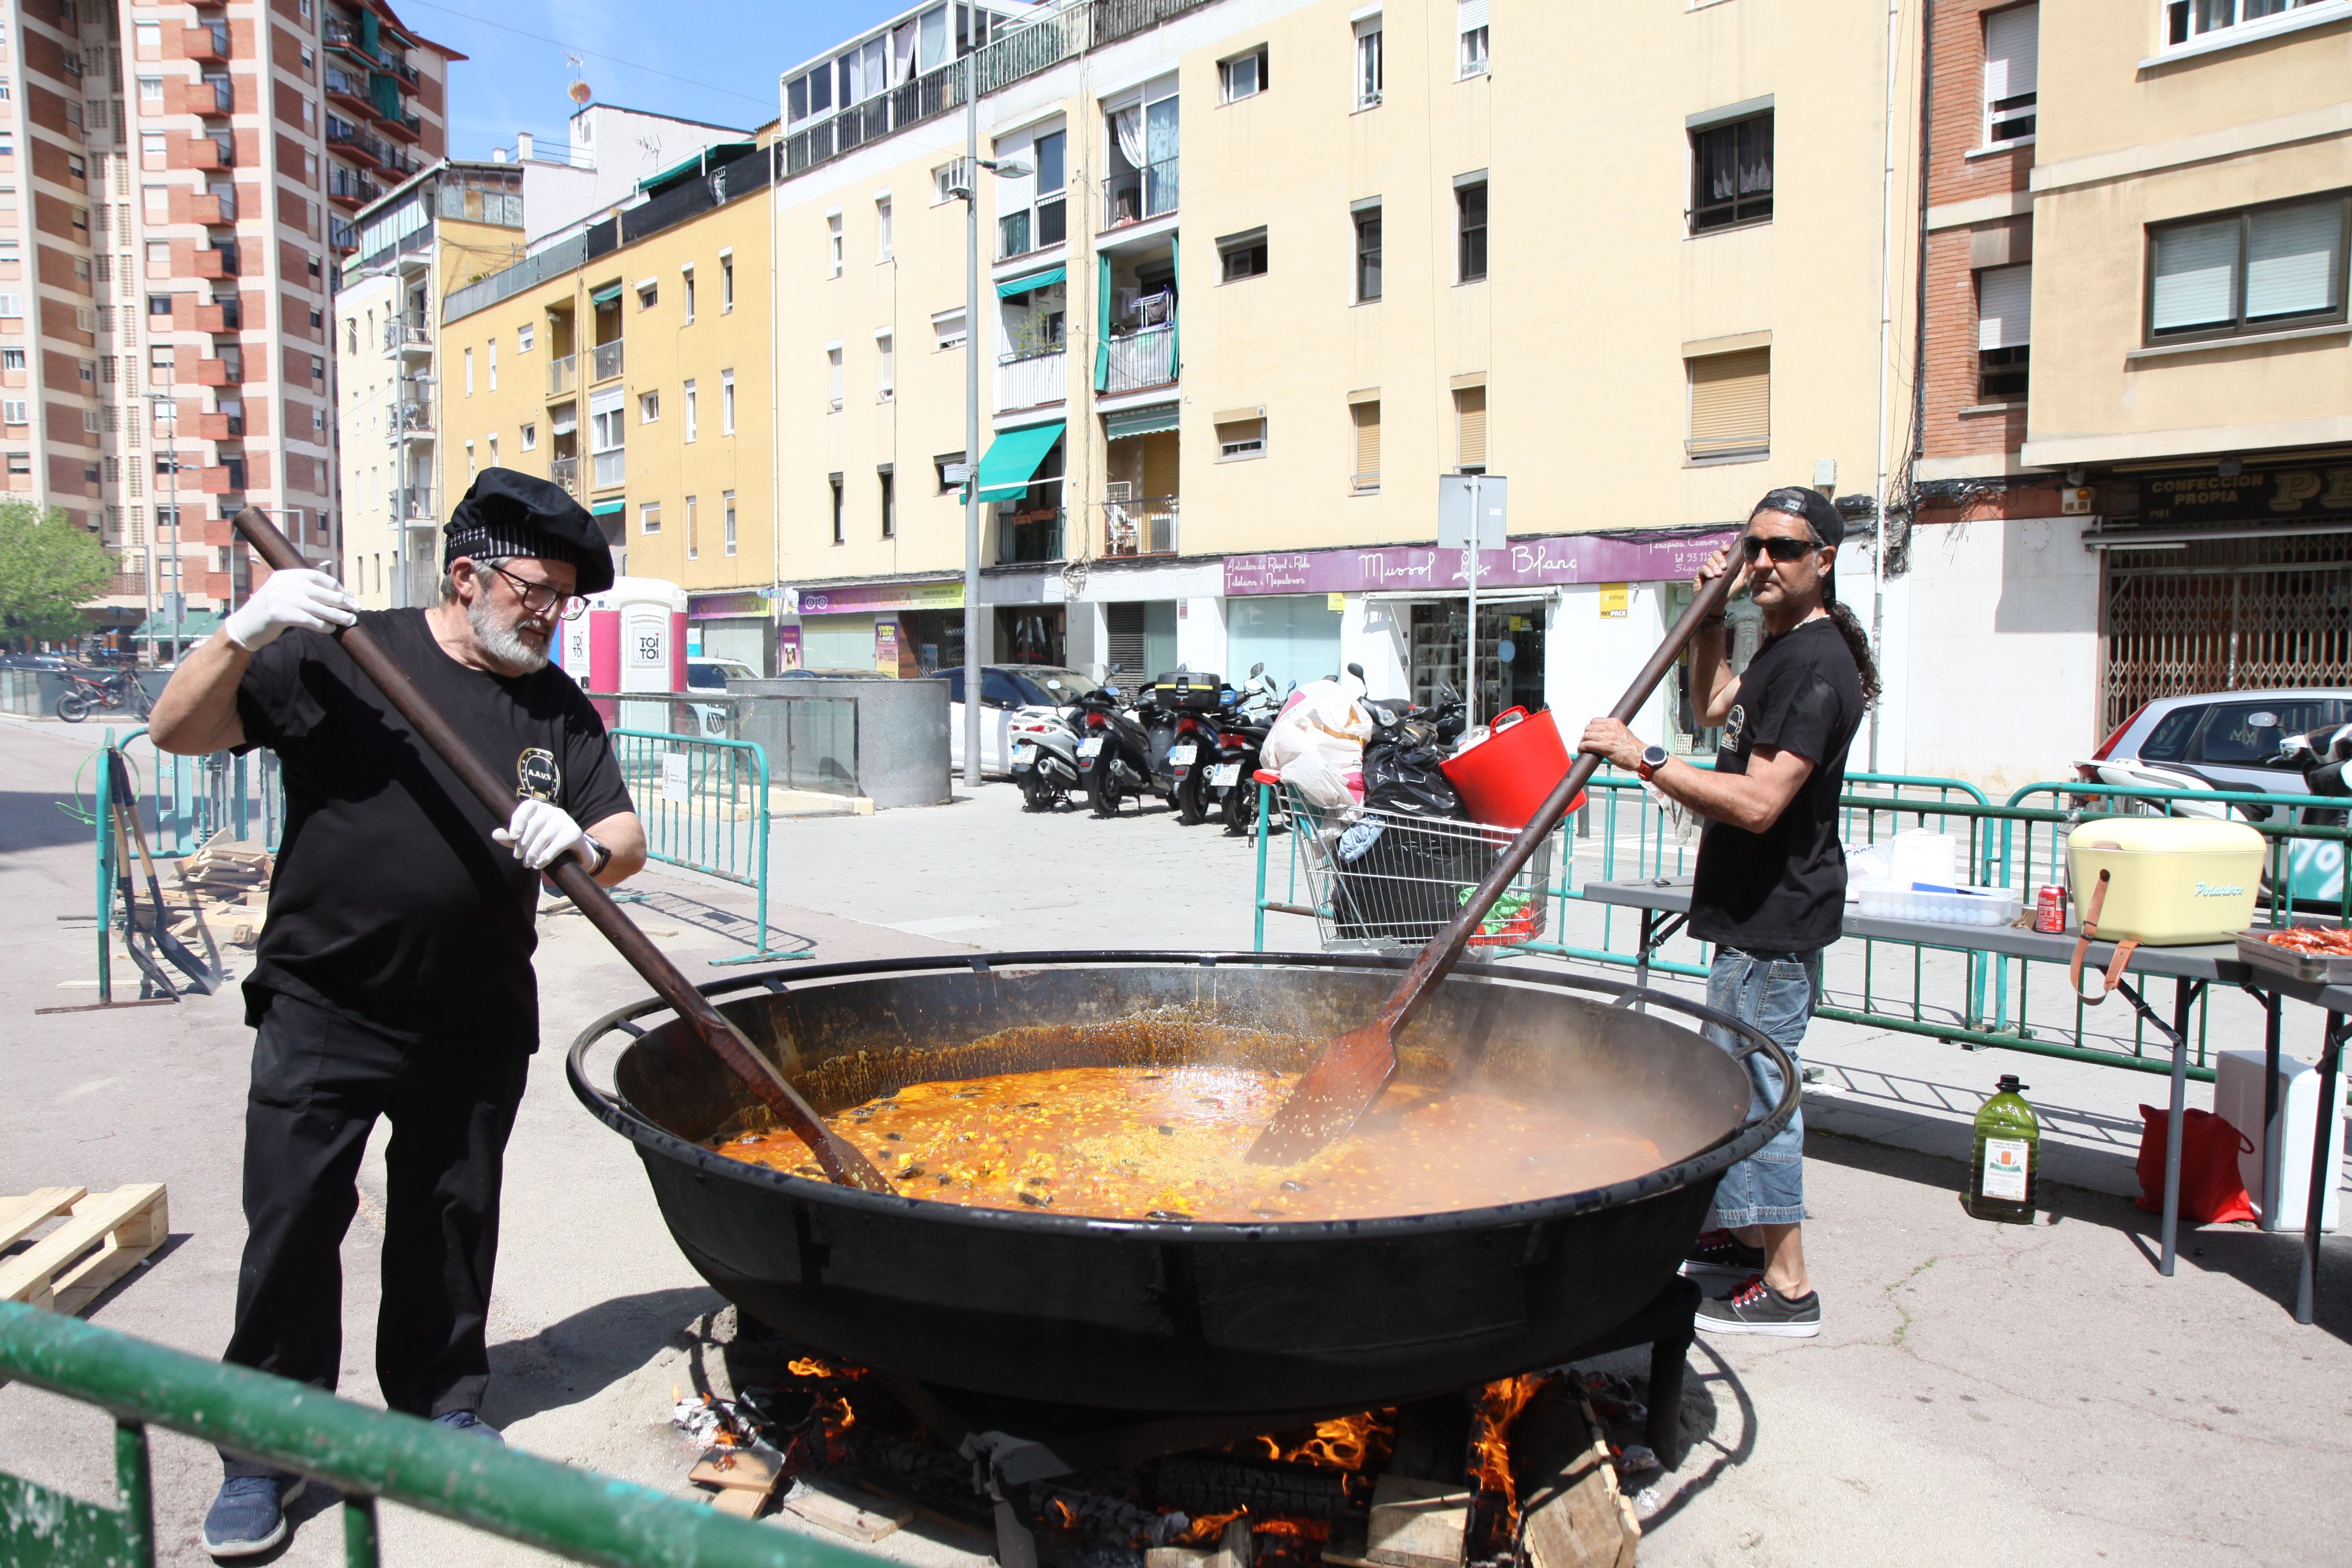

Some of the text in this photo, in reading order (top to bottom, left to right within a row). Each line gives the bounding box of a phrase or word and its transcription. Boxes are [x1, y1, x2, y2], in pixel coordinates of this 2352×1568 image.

[2152, 475, 2263, 492] CONFECCION
[2175, 490, 2238, 505] PROPIA
[1258, 560, 1266, 570] de
[1268, 557, 1287, 573] Regal
[1358, 545, 1577, 584] Mussol Blanc
[1687, 553, 1697, 562] 93
[1266, 573, 1305, 587] Nepalesos
[639, 637, 659, 648] TOI
[639, 649, 659, 659] TOI
[2195, 882, 2244, 897] Polarbox
